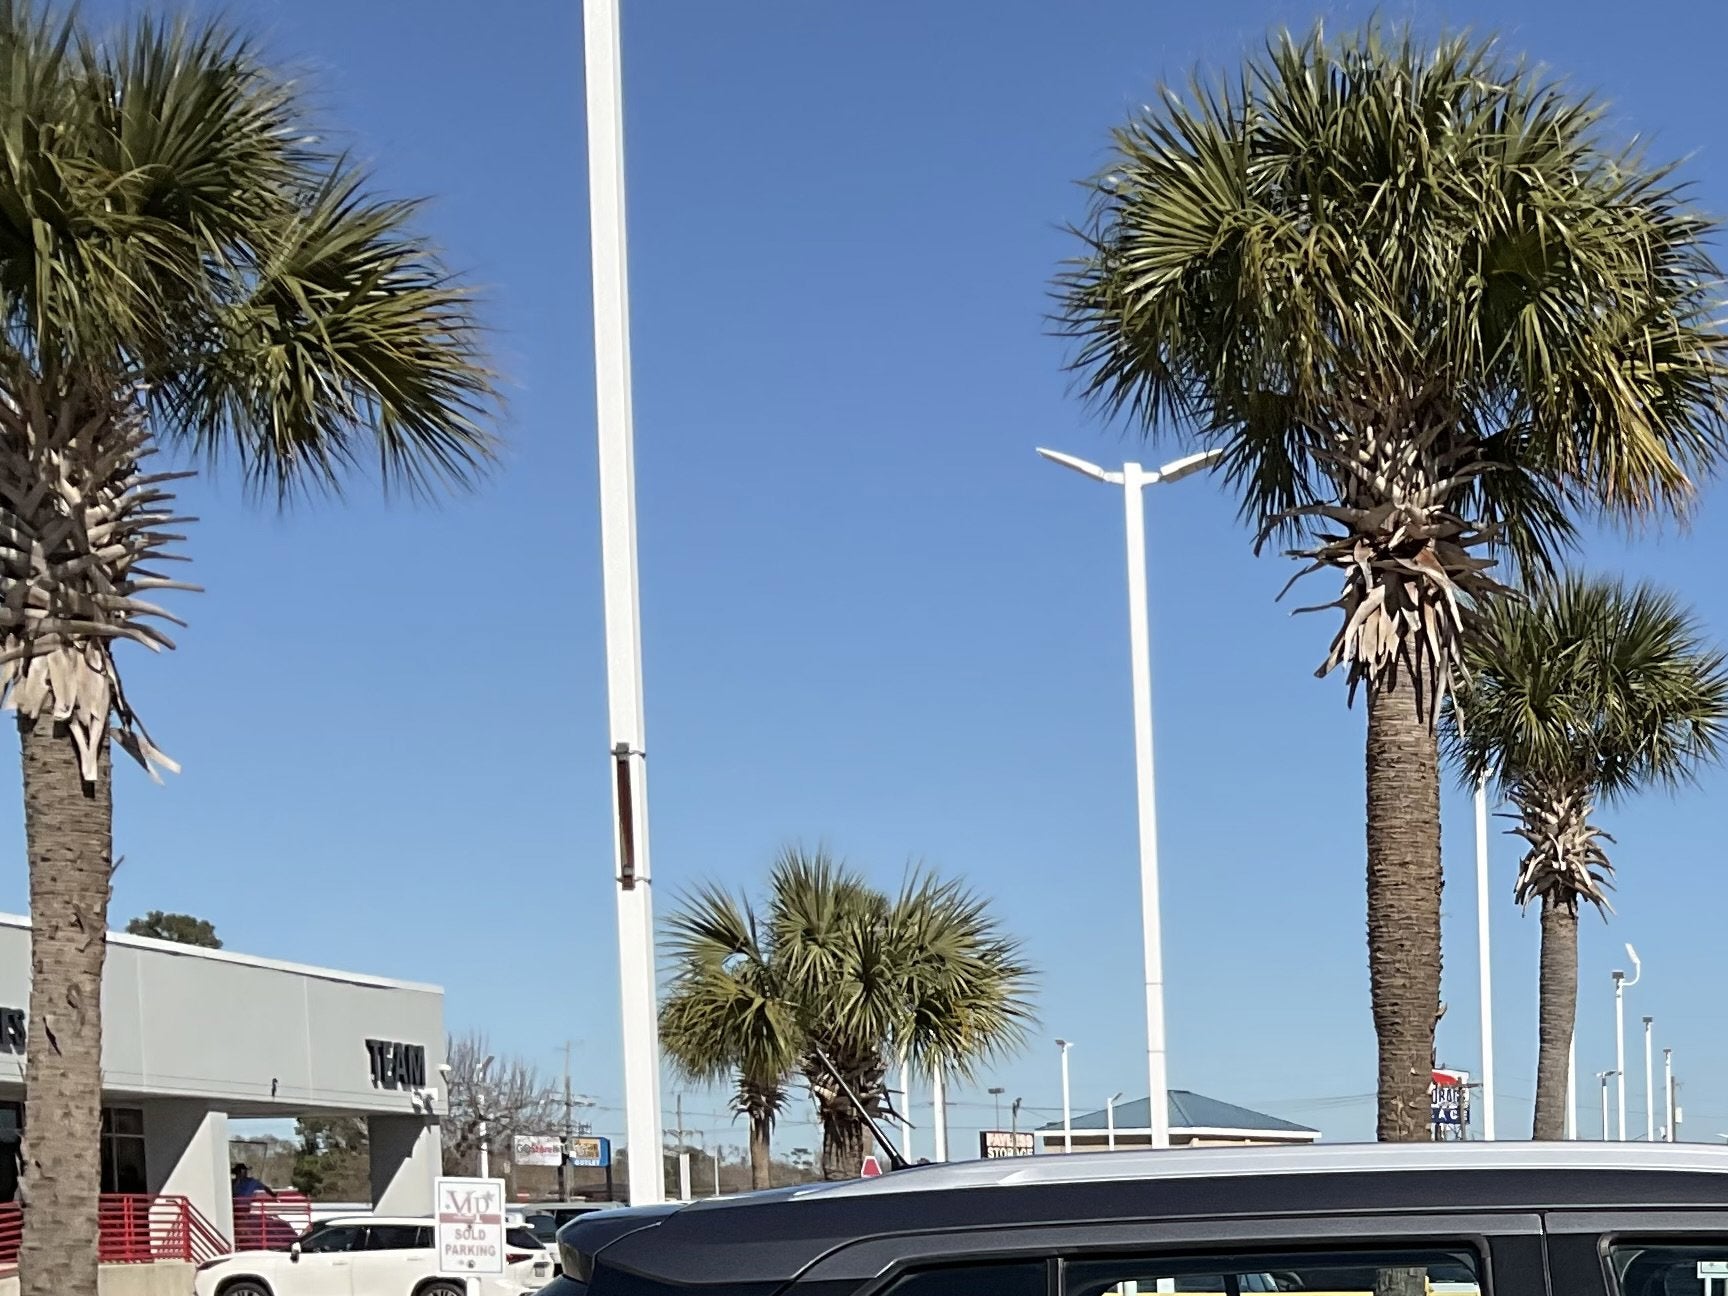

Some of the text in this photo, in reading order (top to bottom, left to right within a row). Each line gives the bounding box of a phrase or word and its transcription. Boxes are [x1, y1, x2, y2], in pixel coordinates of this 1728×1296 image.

[365, 1039, 426, 1092] TEAM
[454, 1228, 486, 1241] SOLD
[445, 1243, 496, 1257] PARKING
